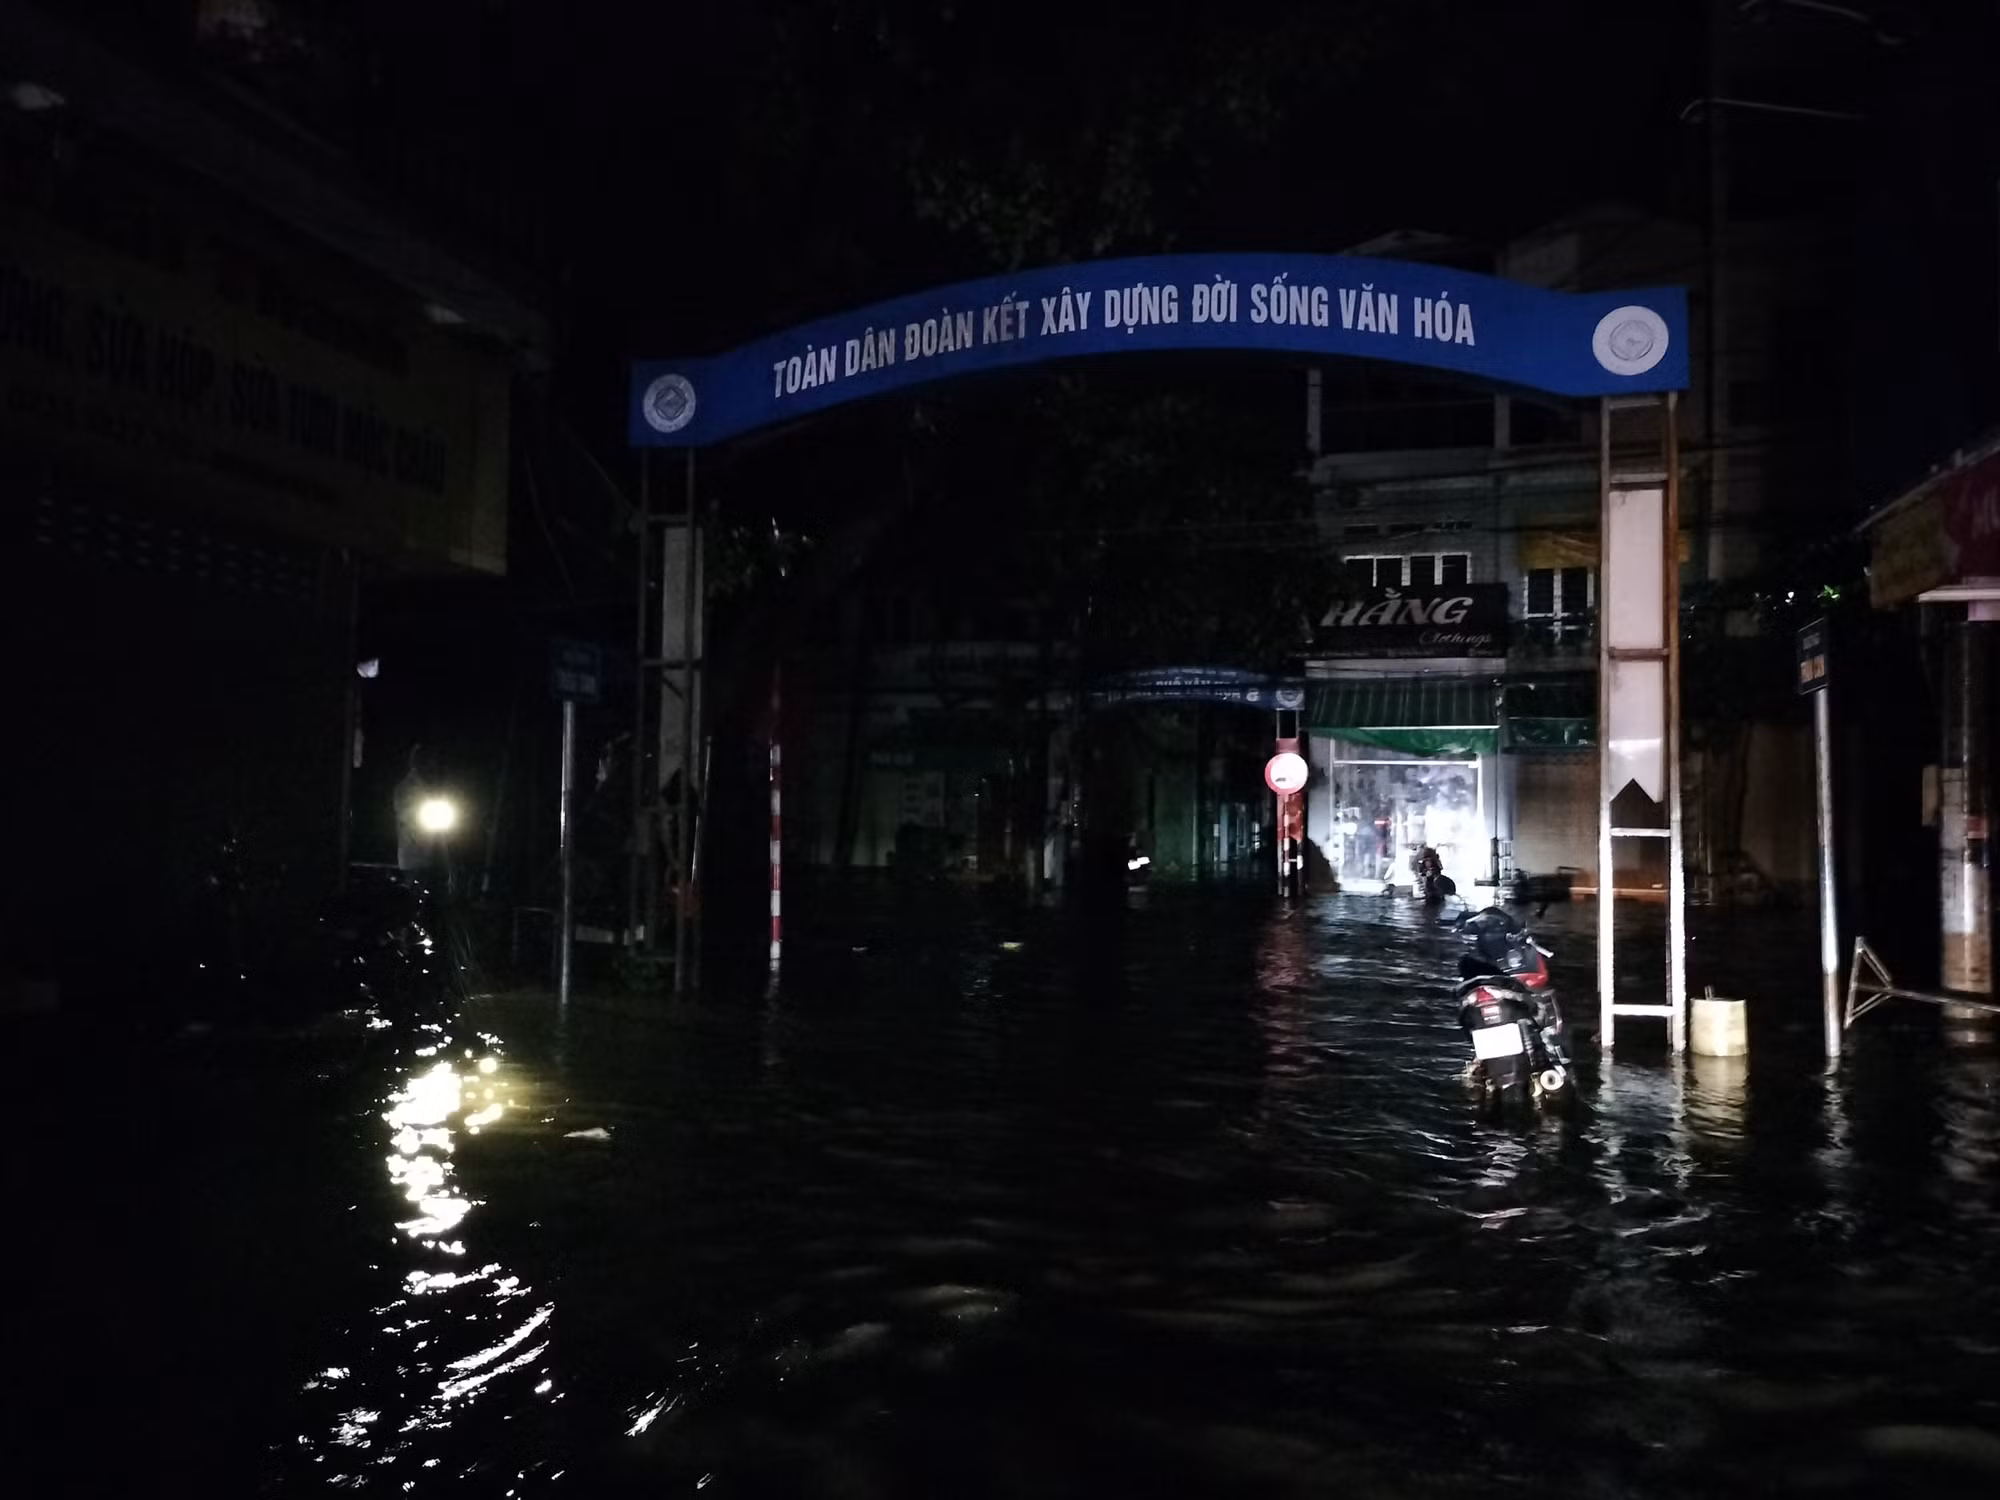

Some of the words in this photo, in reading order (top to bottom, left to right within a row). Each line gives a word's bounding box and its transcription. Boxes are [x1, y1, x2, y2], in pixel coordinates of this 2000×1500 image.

[772, 345, 837, 398] TOÀN
[844, 327, 896, 377] DÂN
[904, 307, 974, 362] ĐOÀN
[982, 291, 1030, 345] KẾT
[1040, 287, 1092, 336] XÂY
[1104, 282, 1179, 334] DỰNG
[1192, 274, 1238, 324] ĐỜI
[1251, 272, 1329, 328] SỐNG
[1339, 283, 1399, 335] VĂN
[1413, 291, 1476, 346] HÓA
